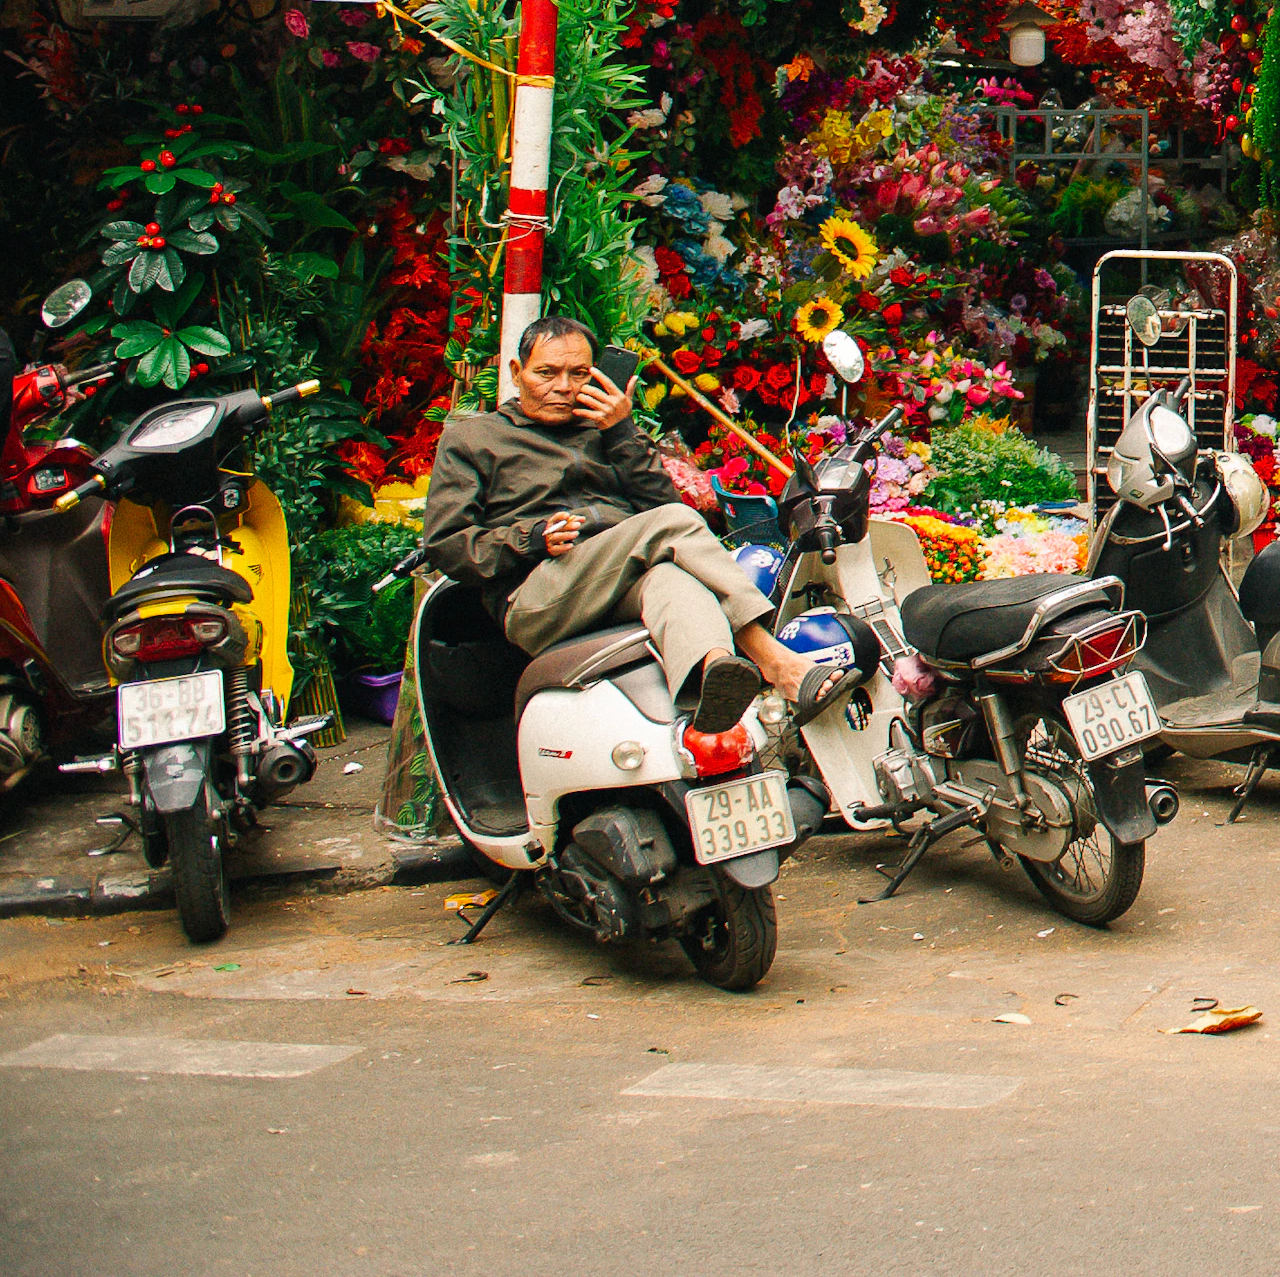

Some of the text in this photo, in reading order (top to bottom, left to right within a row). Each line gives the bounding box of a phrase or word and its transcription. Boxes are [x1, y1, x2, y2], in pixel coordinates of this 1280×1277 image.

[1077, 680, 1138, 723] 29-C1
[1082, 704, 1151, 753] 090.67
[704, 781, 773, 822] 29-AA
[702, 811, 787, 855] 339.33
